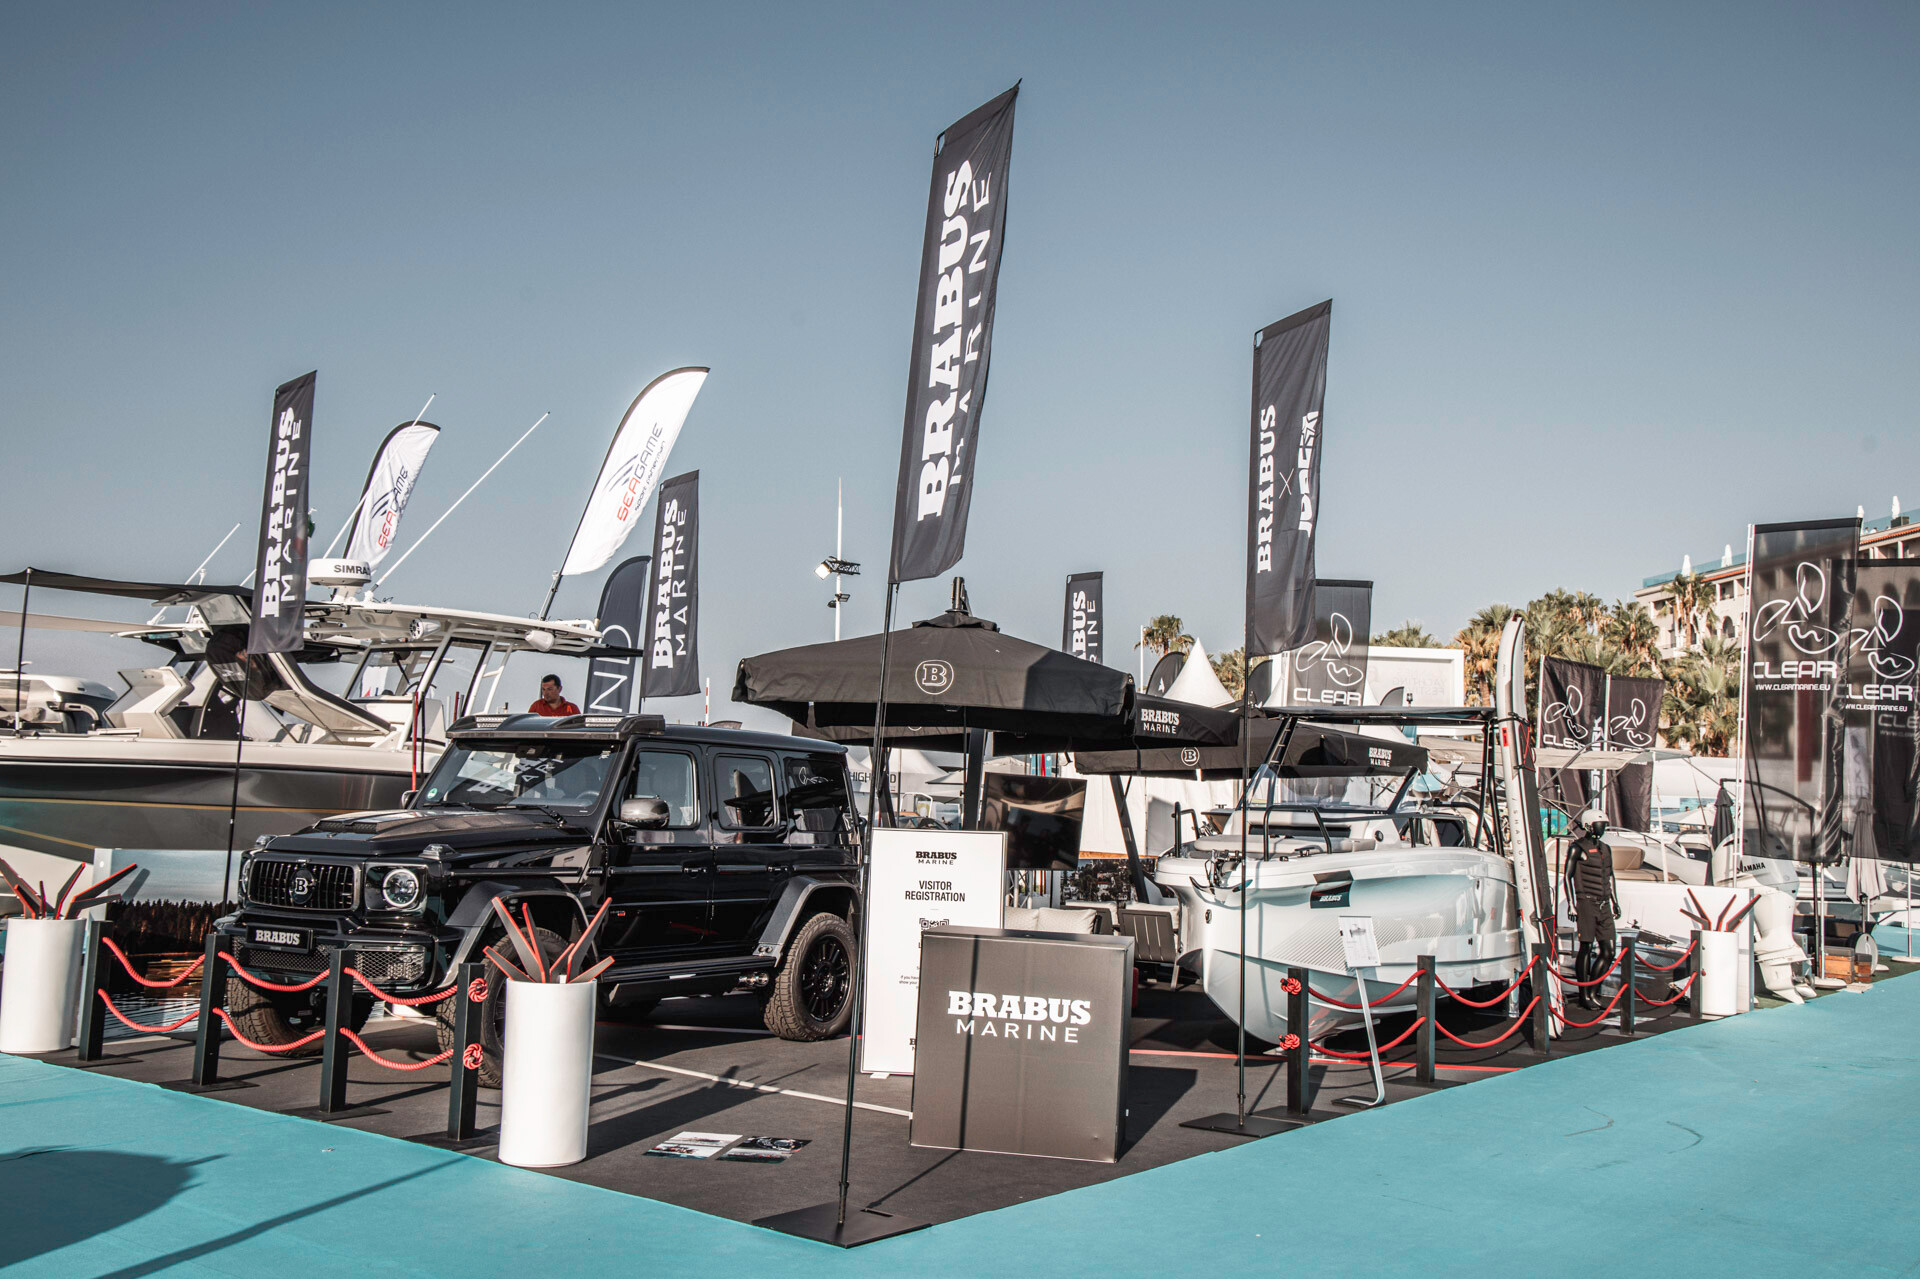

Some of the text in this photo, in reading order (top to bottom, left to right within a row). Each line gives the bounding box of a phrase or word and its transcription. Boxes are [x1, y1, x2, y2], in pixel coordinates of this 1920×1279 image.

[917, 159, 972, 522] BRABUS
[948, 172, 992, 486] MARINE
[616, 422, 663, 522] SEAGAME
[1257, 404, 1276, 573] BRABUS
[260, 407, 294, 618] BRABUS
[280, 419, 302, 602] MARINE
[652, 498, 678, 669] BRABUS
[671, 509, 688, 656] MARINE
[1753, 660, 1838, 679] CLEAR
[1293, 687, 1361, 706] CLEAR
[1140, 708, 1180, 726] BRABUS
[1143, 722, 1177, 734] MARINE
[915, 851, 957, 860] BRABUS
[1736, 860, 1766, 874] YAMAHA
[905, 890, 965, 902] REGISTRATION
[919, 880, 952, 891] VISITOR
[255, 929, 300, 945] BRABUS
[948, 990, 1091, 1025] BRABUS
[956, 1018, 1079, 1043] MARINE
